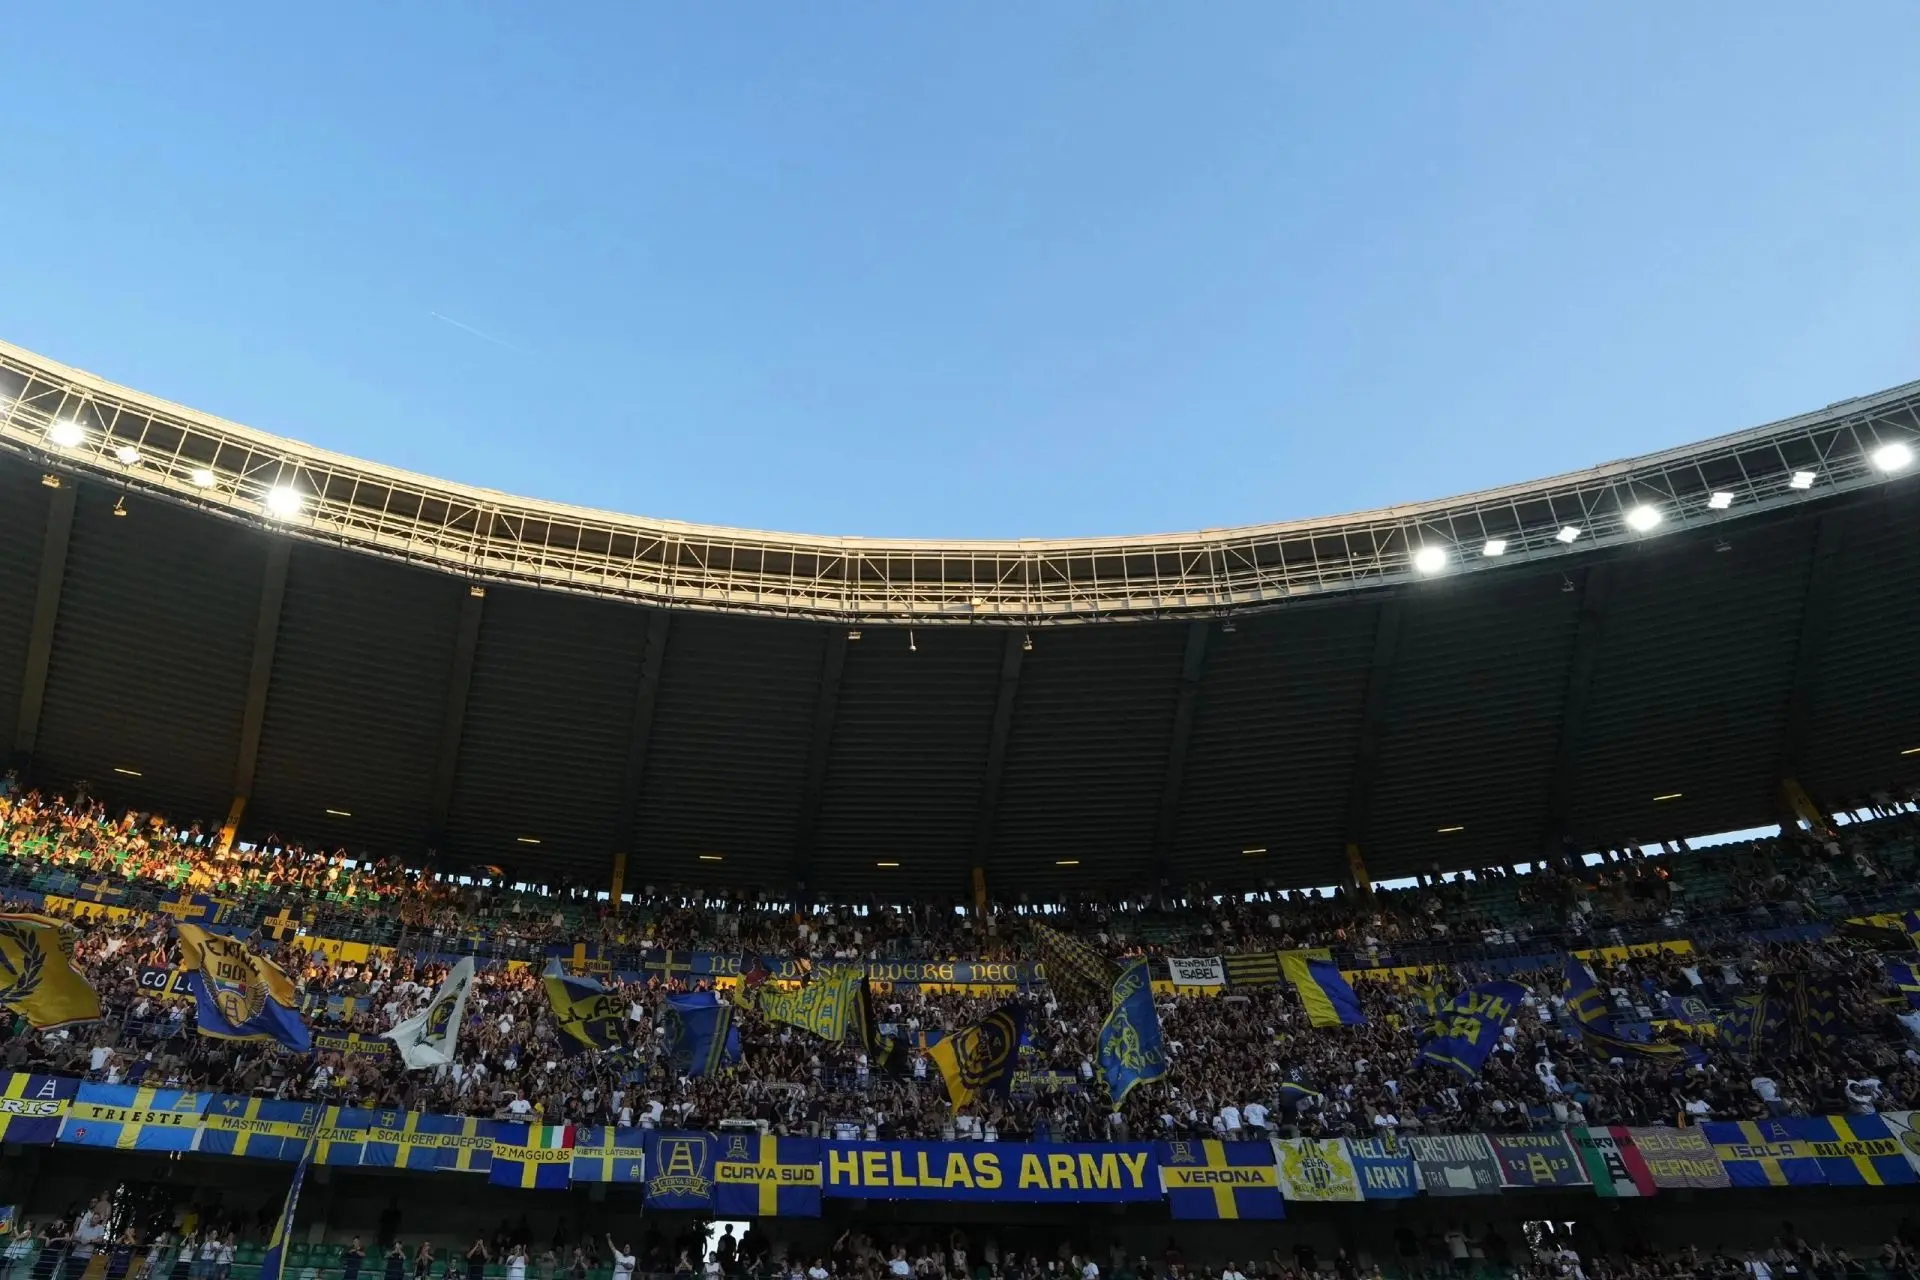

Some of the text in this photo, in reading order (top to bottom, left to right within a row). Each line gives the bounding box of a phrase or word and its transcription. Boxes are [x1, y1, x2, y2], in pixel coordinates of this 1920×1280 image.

[1179, 968, 1218, 979] ISABEL
[318, 1038, 385, 1053] BARDOLINO
[92, 1107, 183, 1125] TRIESTE
[221, 1118, 273, 1133] MASTINI
[377, 1130, 493, 1149] SCALIGERI QUEPOS
[1496, 1135, 1560, 1149] VERONA
[495, 1146, 570, 1161] 12 MAGGIO 85
[1408, 1134, 1489, 1162] CRISTIANO
[1731, 1143, 1795, 1158] ISOLA
[1813, 1140, 1896, 1156] BELGRADO
[720, 1165, 814, 1181] CURVA SUD
[829, 1150, 1148, 1189] HELLAS ARMY
[1649, 1158, 1721, 1177] VERONA
[1177, 1170, 1266, 1183] VERONA
[1364, 1165, 1410, 1189] ARMY
[1425, 1171, 1446, 1187] TRA
